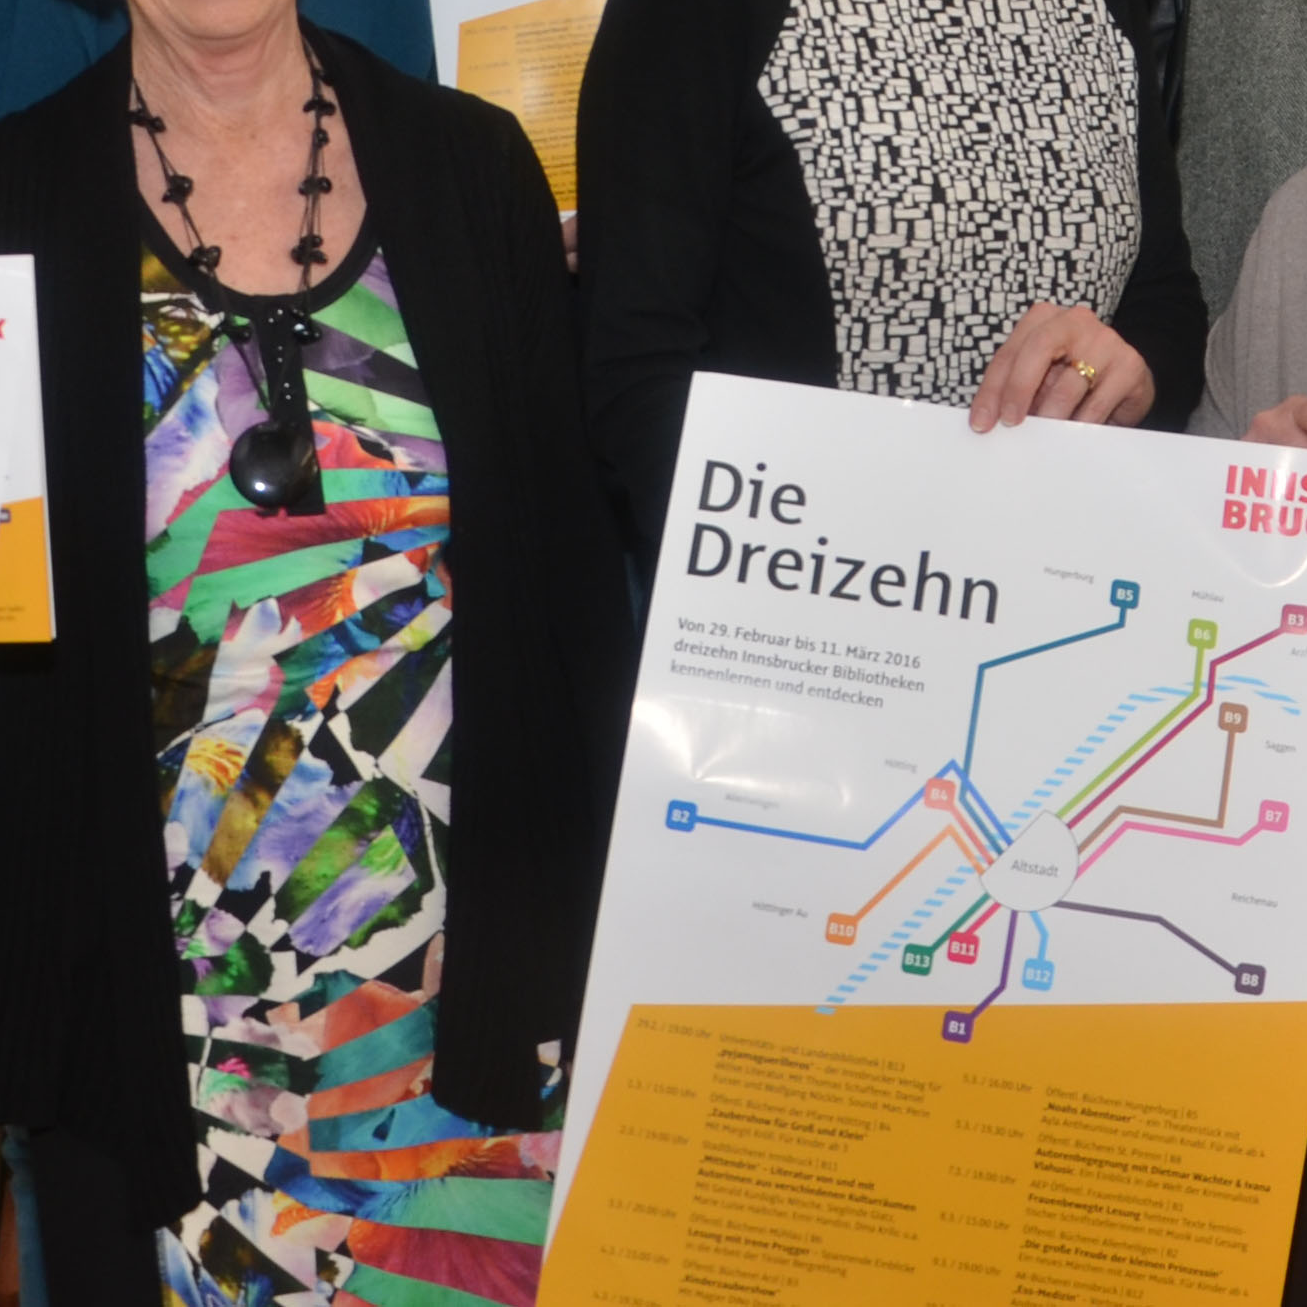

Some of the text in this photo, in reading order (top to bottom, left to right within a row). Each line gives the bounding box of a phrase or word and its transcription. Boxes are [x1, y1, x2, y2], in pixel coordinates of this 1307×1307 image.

[698, 459, 807, 525] Die
[687, 522, 1001, 624] Dreizehn
[1115, 587, 1135, 602] B5
[1286, 612, 1305, 627] B3
[1192, 627, 1211, 642] B6
[676, 616, 922, 669] Von 29. Februar bis 11. März 2016
[672, 639, 925, 692] dreizehn Innsbrucker Bibliotheken
[669, 660, 884, 708] kennenlernen und entdecken
[1223, 711, 1242, 725] B9
[930, 787, 949, 801] B4
[670, 808, 691, 823] B2
[1264, 808, 1283, 823] B7
[1011, 859, 1059, 878] Altstadt
[1230, 892, 1278, 908] Reichenau
[828, 923, 856, 938] B10
[950, 940, 976, 957] B11
[904, 952, 931, 968] B13
[1024, 966, 1051, 982] B12
[1241, 972, 1259, 987] B8
[949, 1020, 967, 1035] B1
